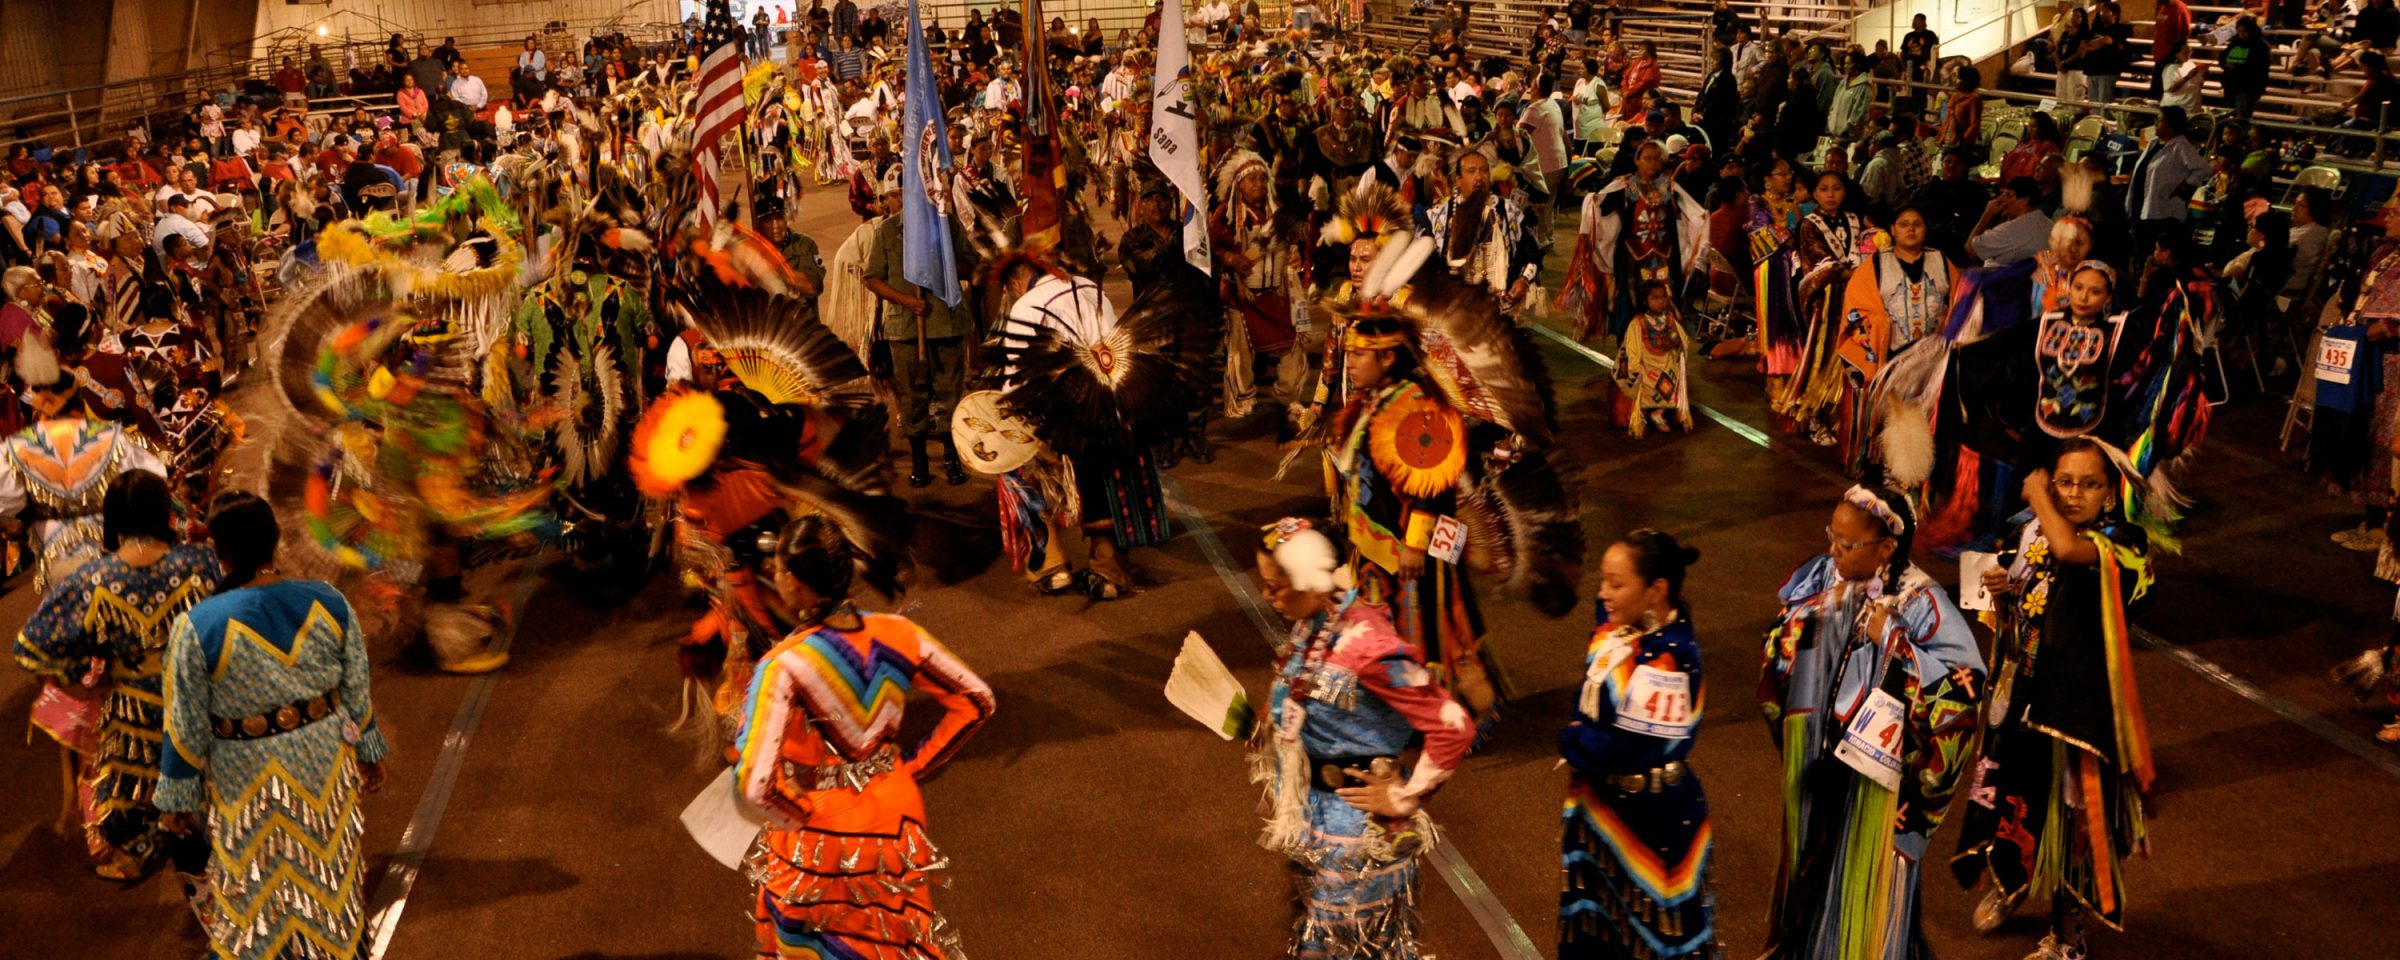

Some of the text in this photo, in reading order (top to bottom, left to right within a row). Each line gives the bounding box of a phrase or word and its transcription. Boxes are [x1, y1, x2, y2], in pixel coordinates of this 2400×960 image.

[1153, 127, 1178, 155] Sapa
[2325, 349, 2348, 366] 435
[1432, 517, 1459, 552] 521
[1853, 706, 1877, 734] W
[1848, 735, 1876, 757] IGNACIO
